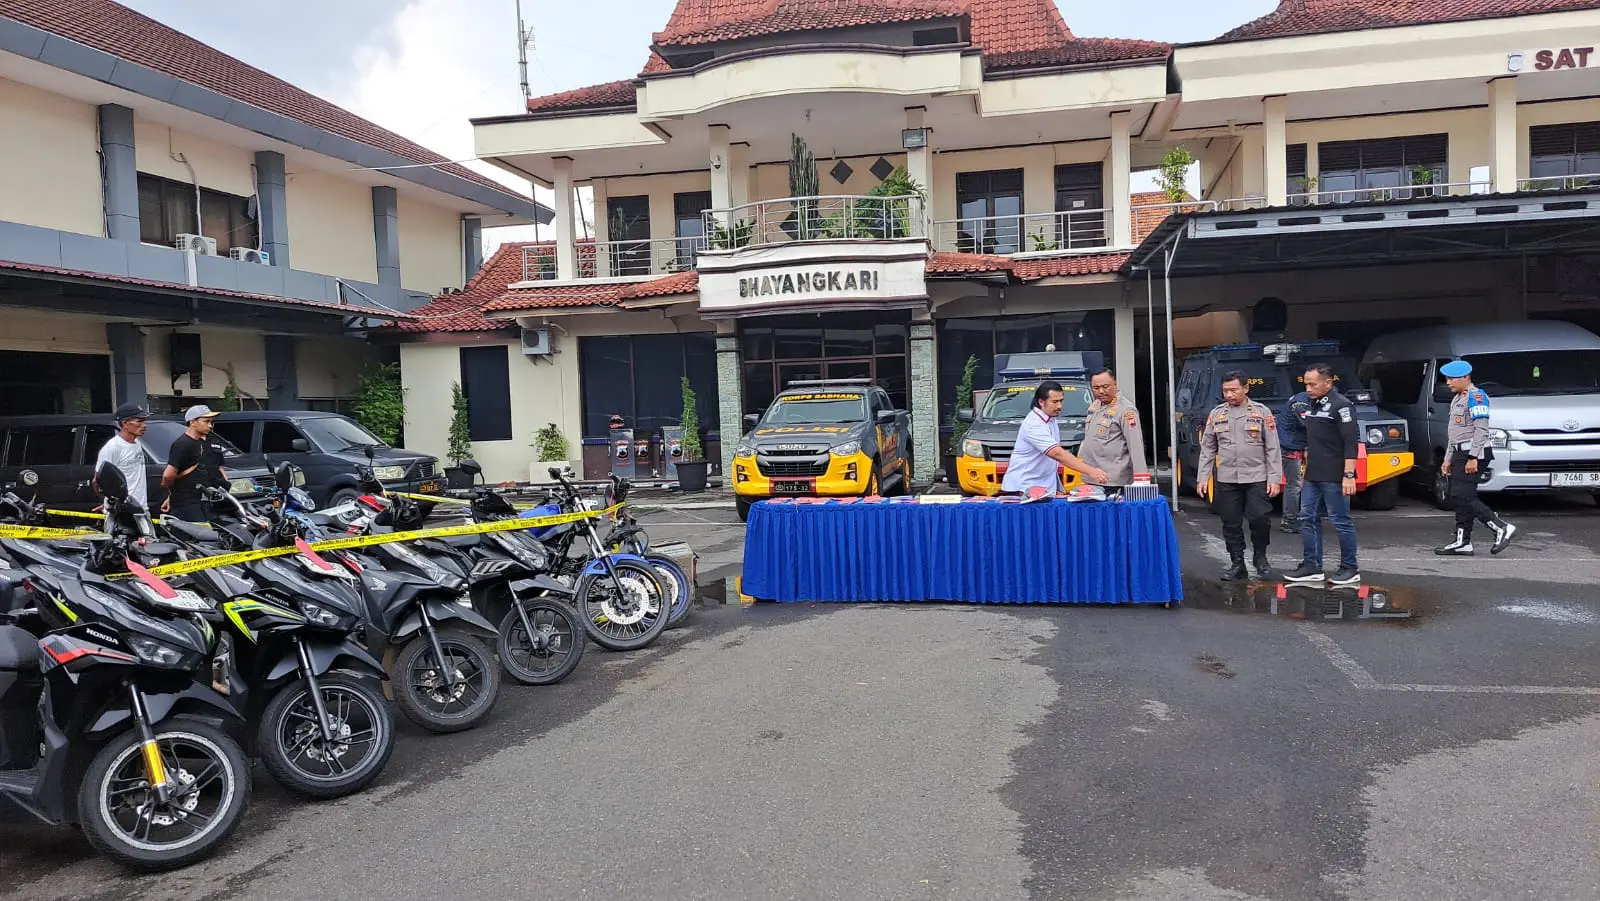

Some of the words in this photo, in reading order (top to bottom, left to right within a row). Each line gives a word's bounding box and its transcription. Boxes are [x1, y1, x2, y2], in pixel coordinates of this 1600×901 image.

[1534, 46, 1594, 70] SAT
[739, 270, 879, 298] BHAYANGKARI
[755, 426, 850, 436] POLISI
[265, 592, 290, 607] HONDA
[85, 627, 120, 645] HONDA
